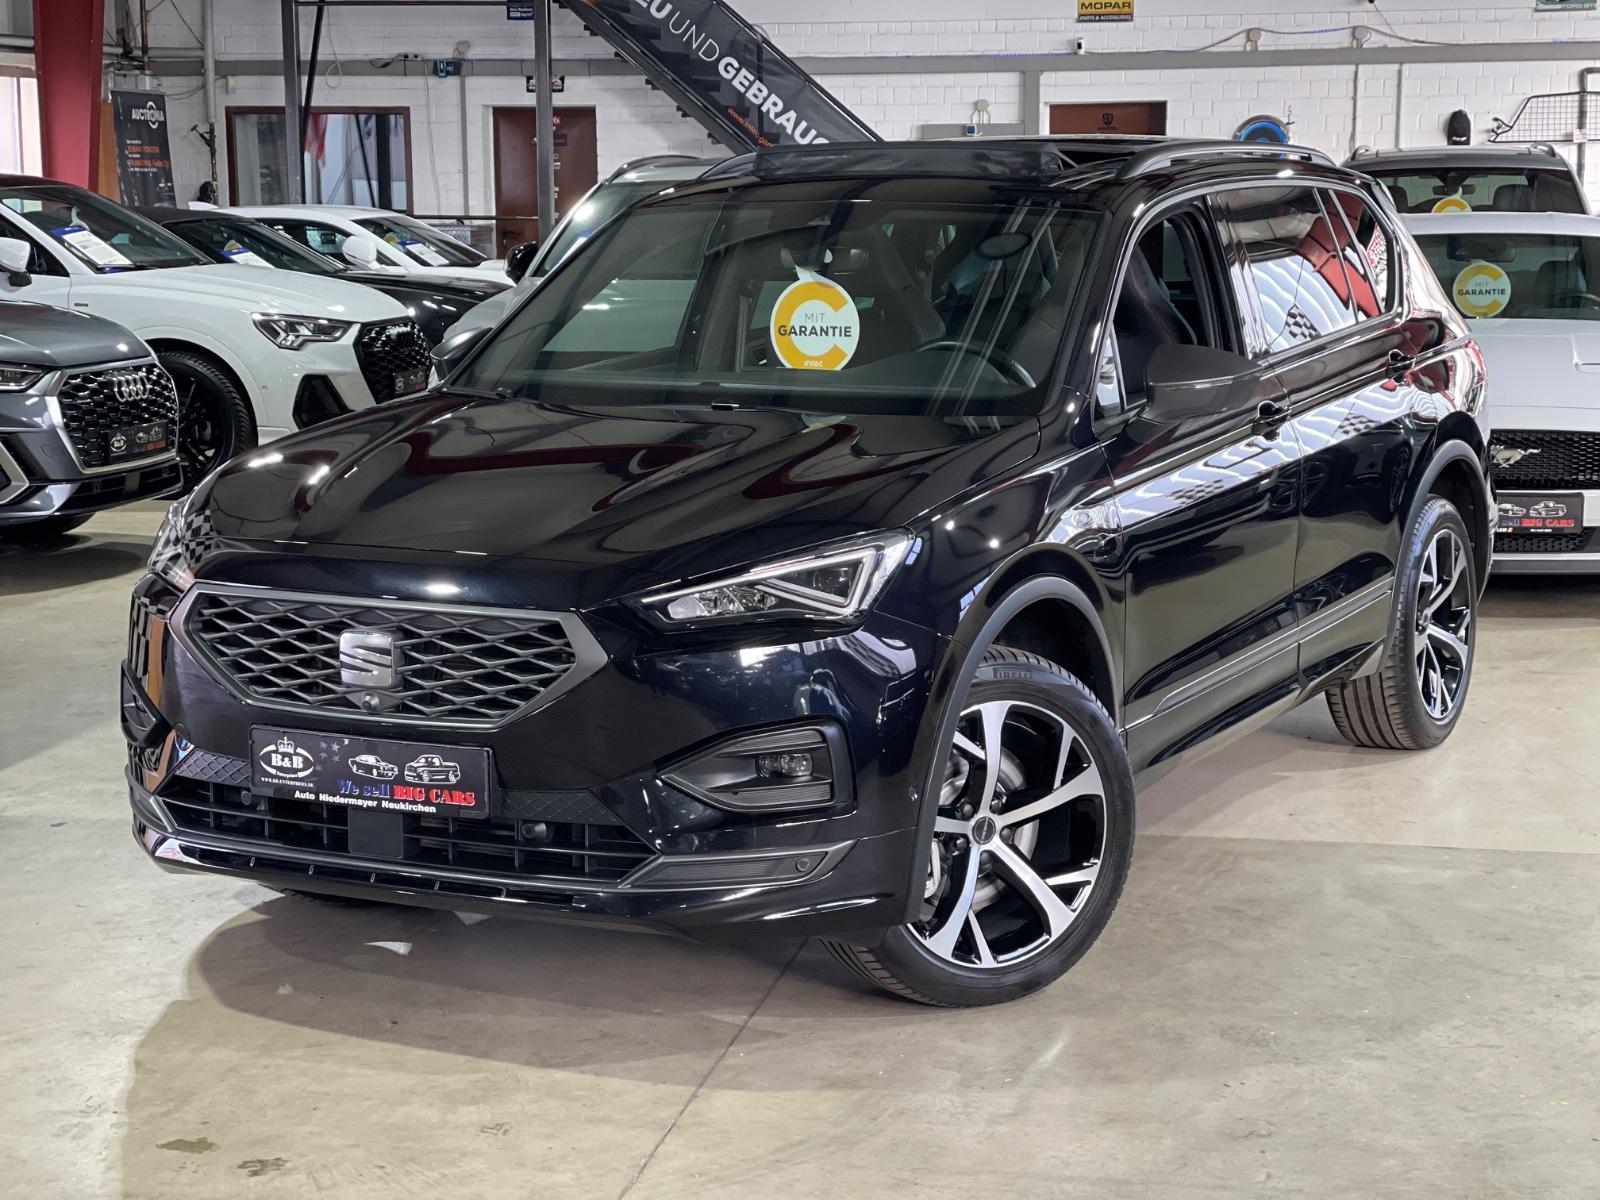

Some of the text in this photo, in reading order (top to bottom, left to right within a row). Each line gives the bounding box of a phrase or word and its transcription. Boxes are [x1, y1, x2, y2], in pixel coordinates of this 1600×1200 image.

[668, 11, 720, 61] UND
[1457, 288, 1507, 296] GARANTIE
[804, 313, 826, 323] MIT
[778, 325, 852, 337] GARANTIE
[271, 753, 304, 769] B&B
[337, 779, 476, 806] We sell BIG CARS
[294, 790, 437, 813] Auto Niedermayer Neukirchen
